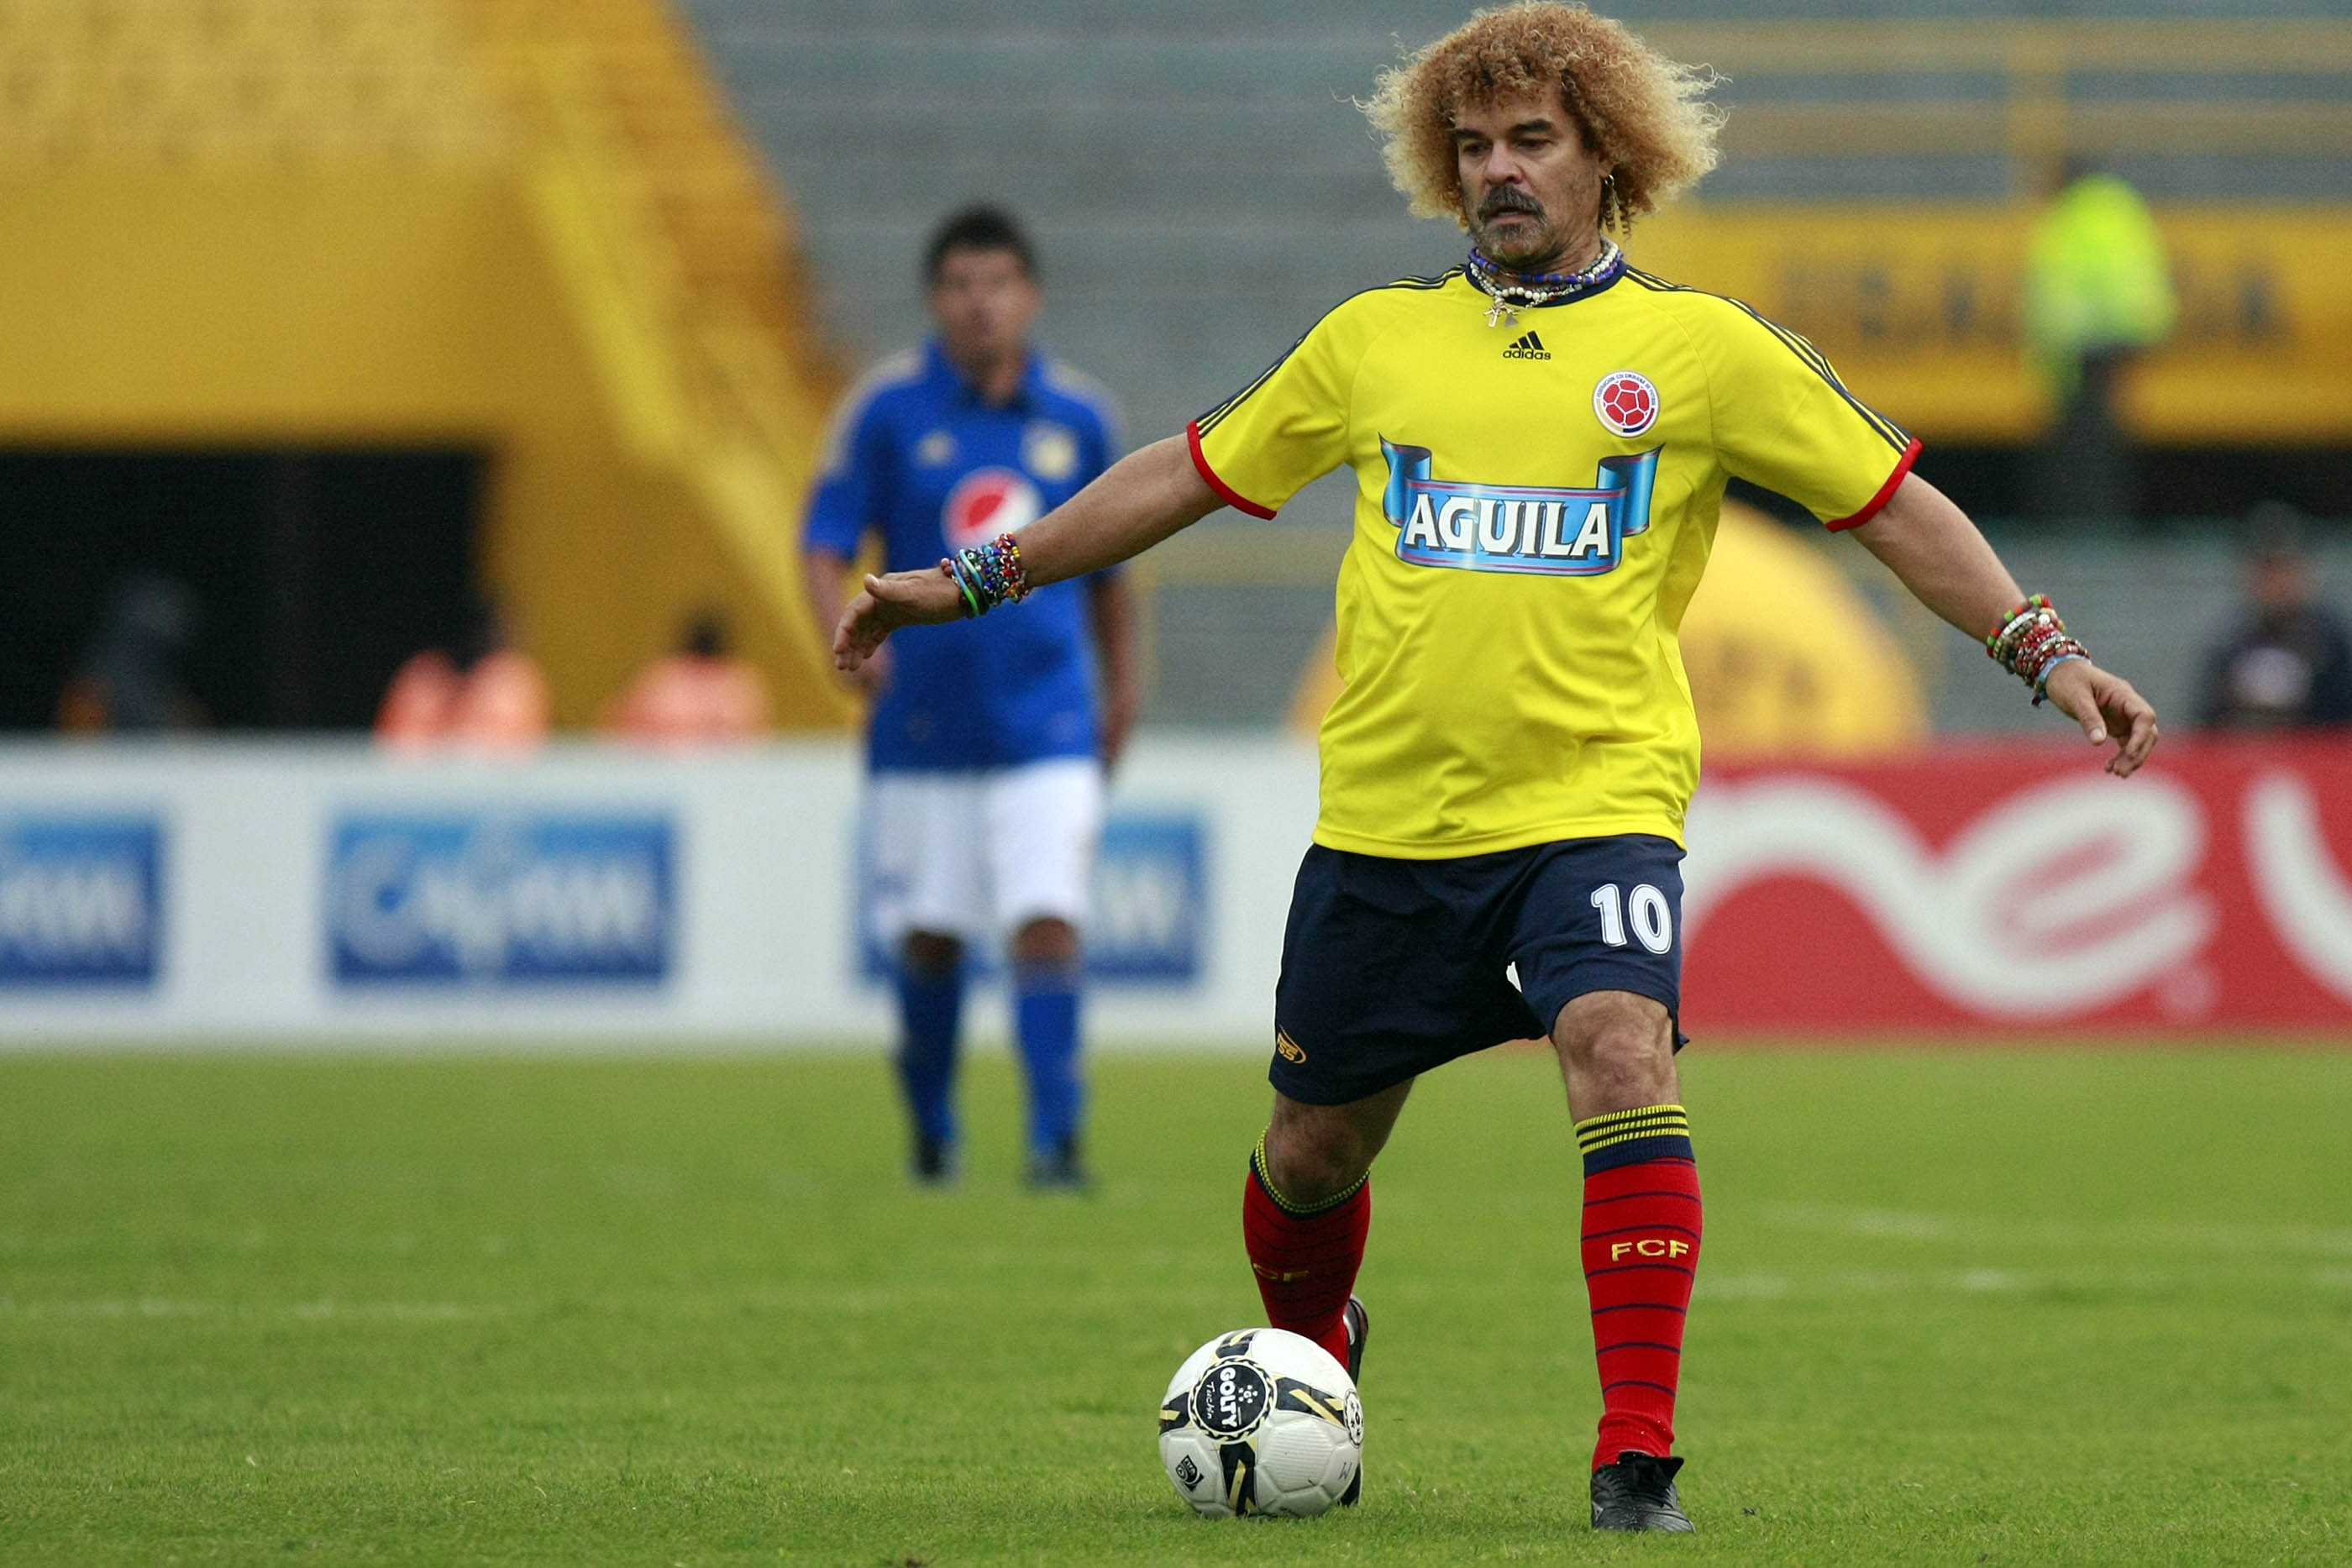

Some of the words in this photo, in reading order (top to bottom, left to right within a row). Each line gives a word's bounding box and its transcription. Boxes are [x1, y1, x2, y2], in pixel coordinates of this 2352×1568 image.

[1503, 347, 1551, 360] adidas
[1404, 492, 1614, 560] AGUILA
[1590, 883, 1672, 955] 10
[1611, 1239, 1689, 1261] FCF
[1252, 1262, 1310, 1282] CF
[1220, 1367, 1237, 1427] GOLTY
